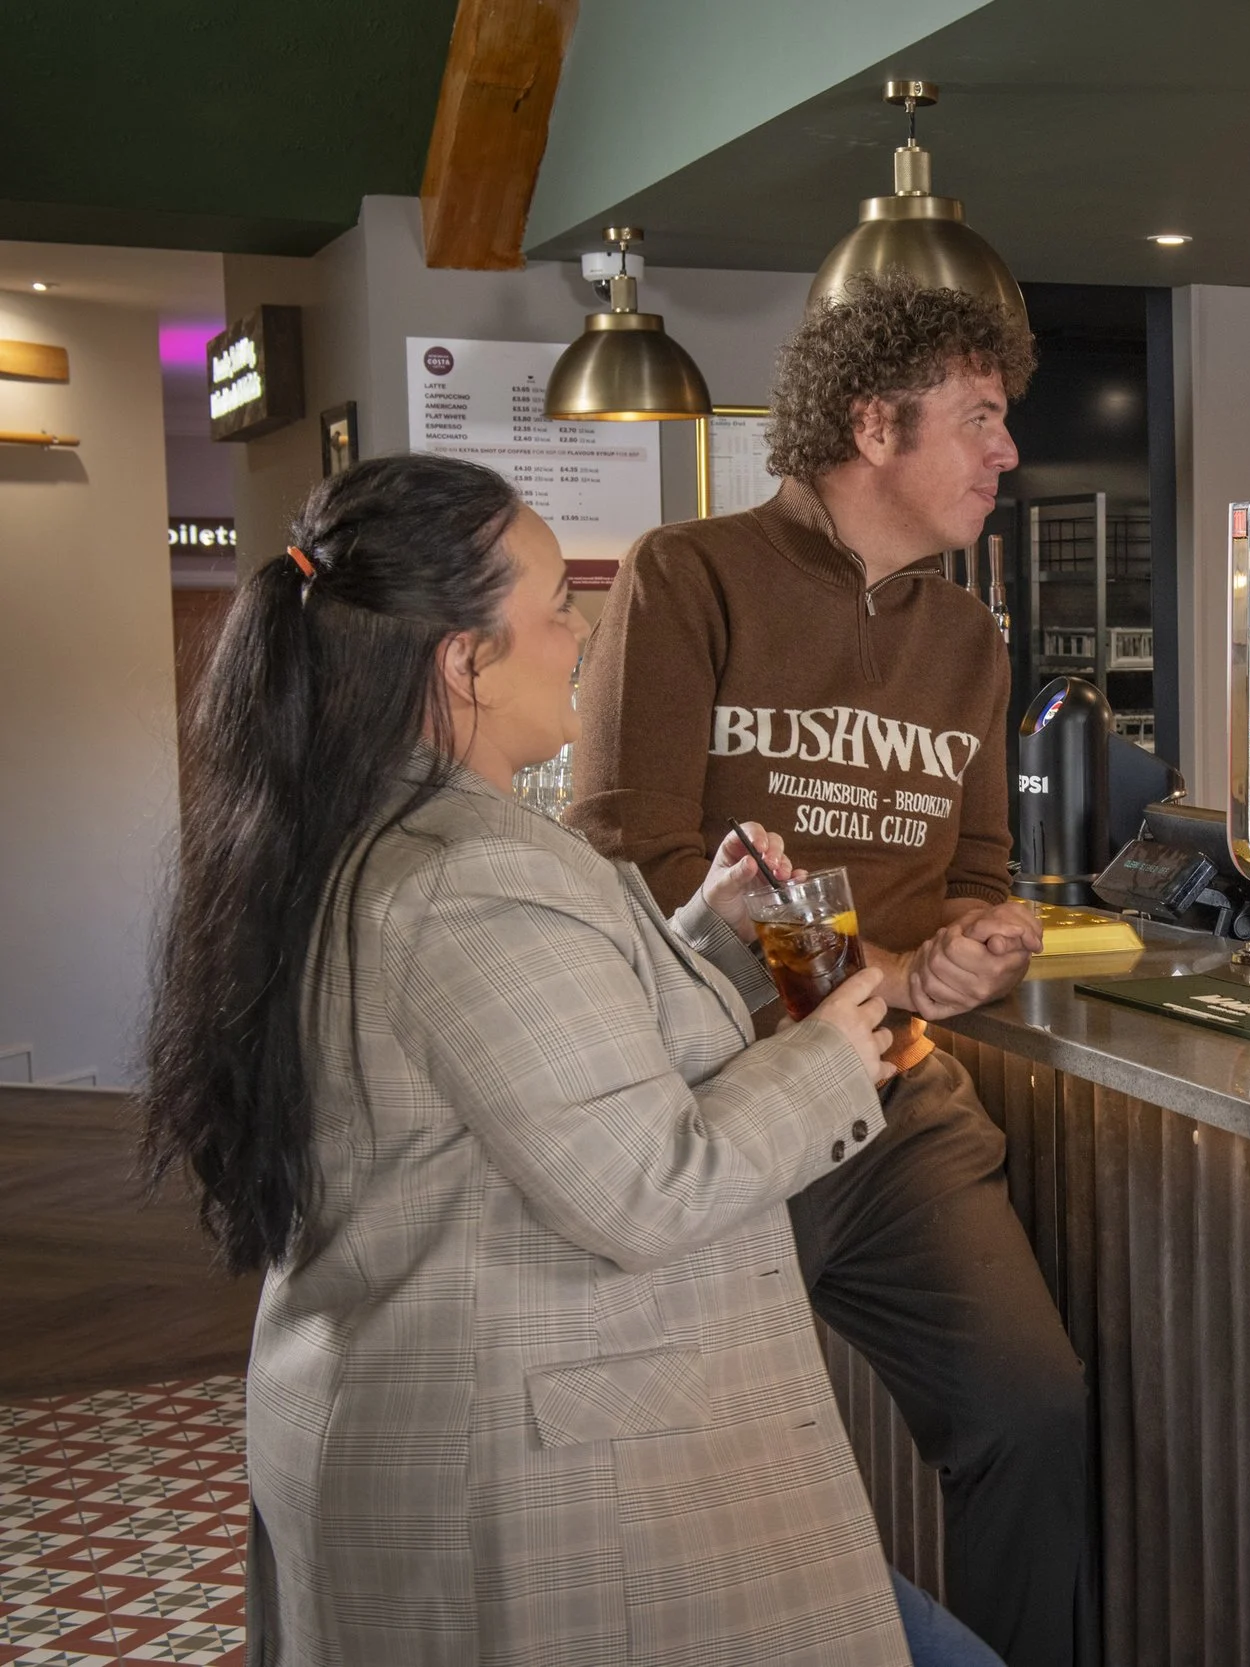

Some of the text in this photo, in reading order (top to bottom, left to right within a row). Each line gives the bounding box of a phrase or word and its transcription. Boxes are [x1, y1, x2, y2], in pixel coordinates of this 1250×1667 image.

[427, 358, 450, 366] COSTA
[768, 771, 878, 810] WILLIAMSBURG
[895, 789, 953, 819] BROOKLYN
[794, 804, 928, 848] SOCIAL CLUB
